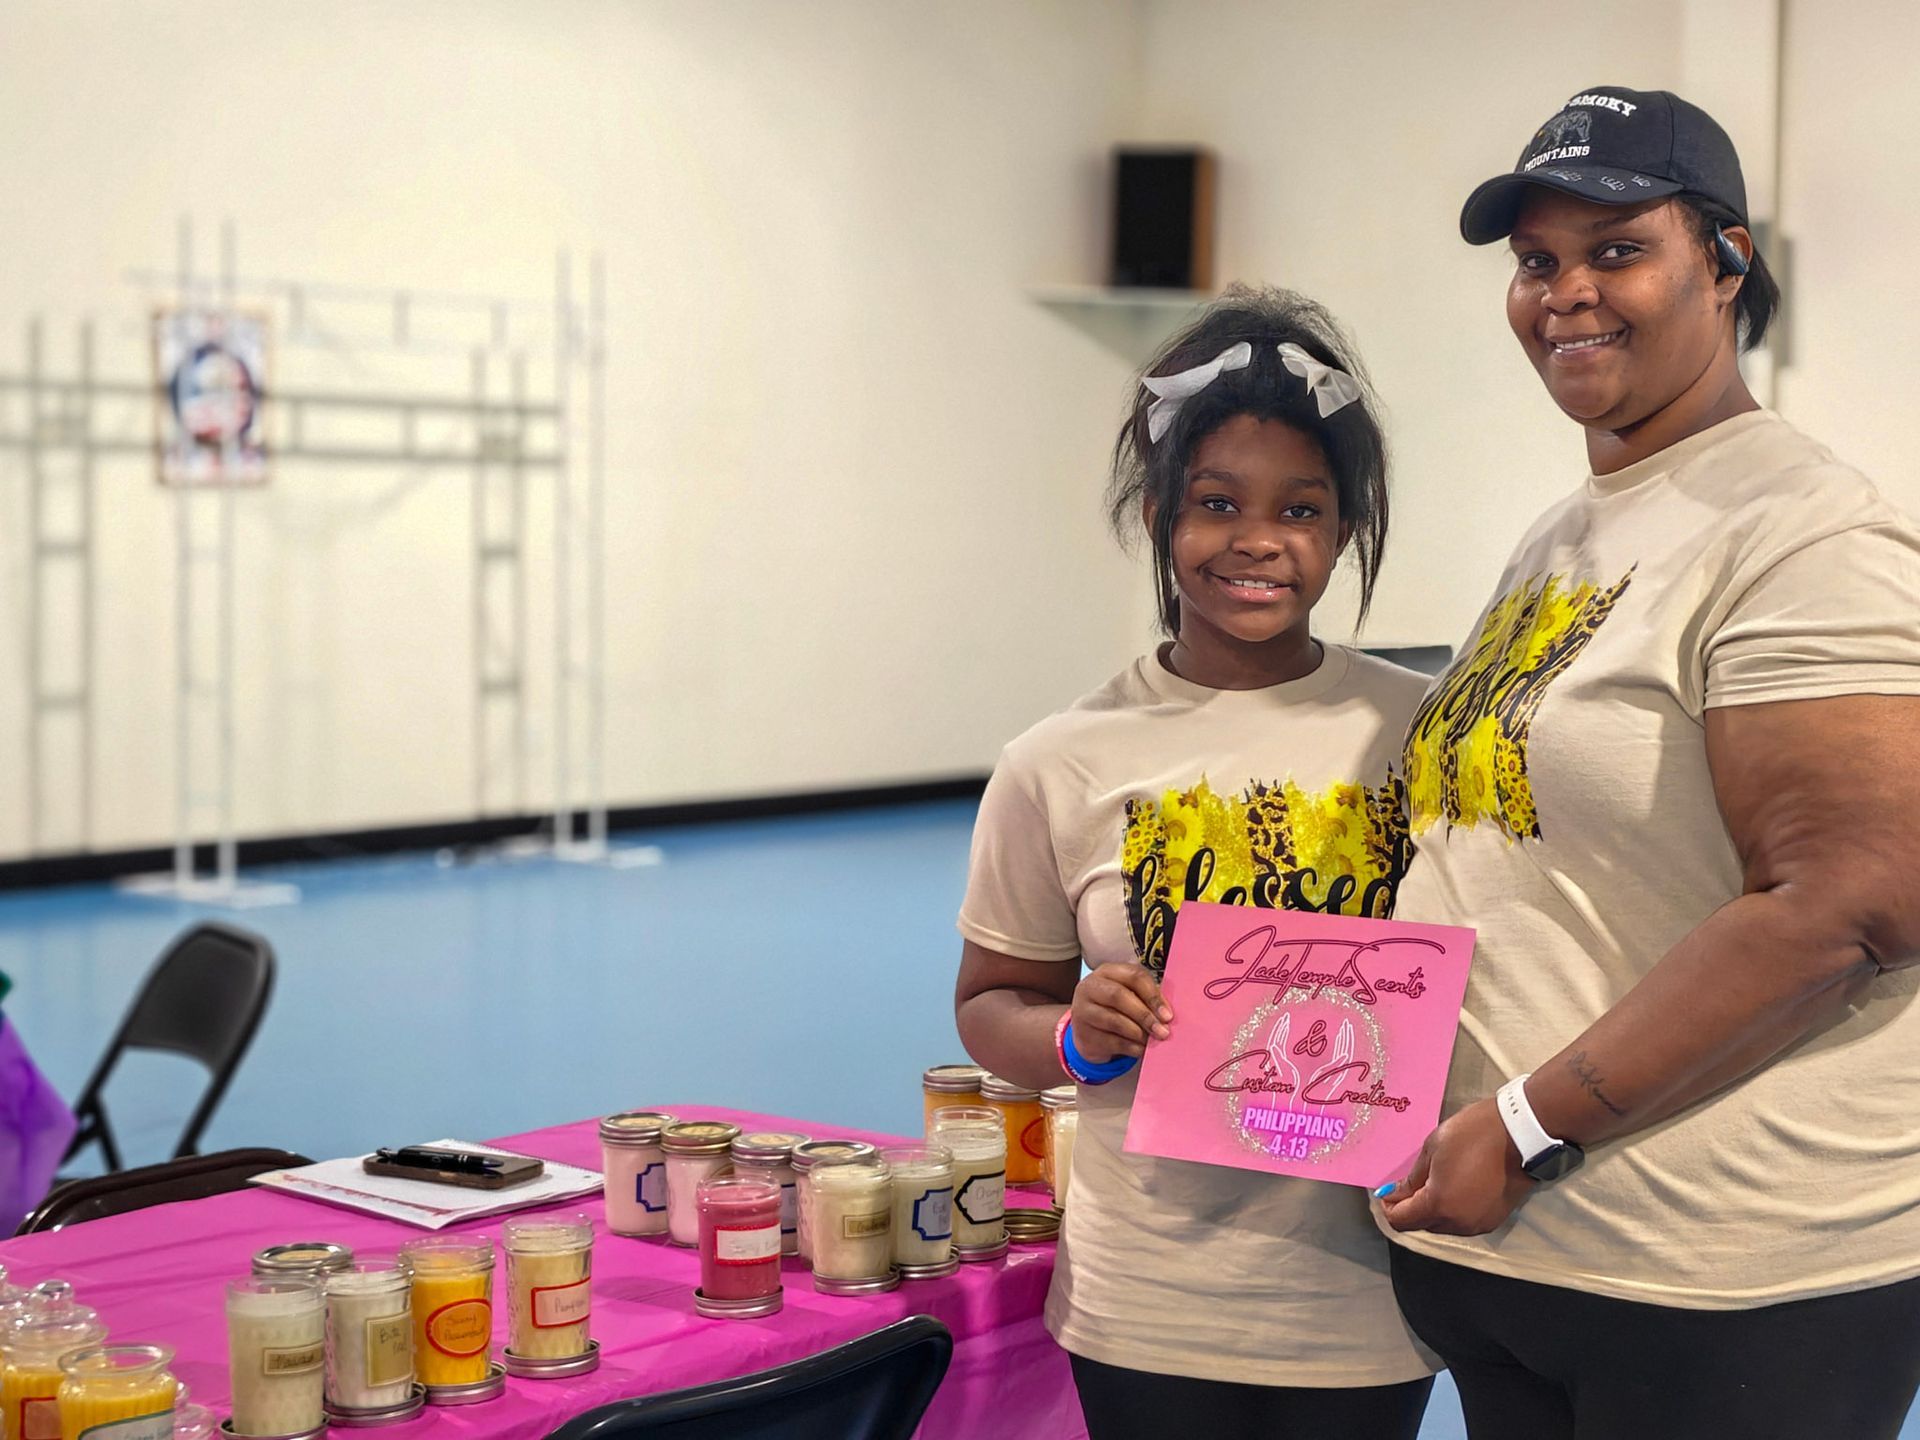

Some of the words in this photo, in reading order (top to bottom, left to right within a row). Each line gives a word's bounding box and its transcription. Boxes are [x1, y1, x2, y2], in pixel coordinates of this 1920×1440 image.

[1568, 94, 1637, 117] SMOKY
[1523, 145, 1591, 172] MOUNTAINS
[1293, 1019, 1328, 1057] &
[1204, 1049, 1295, 1092] Custom
[1301, 1061, 1411, 1113] Creations
[1243, 1107, 1346, 1141] PHILIPPIANS
[1269, 1134, 1309, 1158] 4:13
